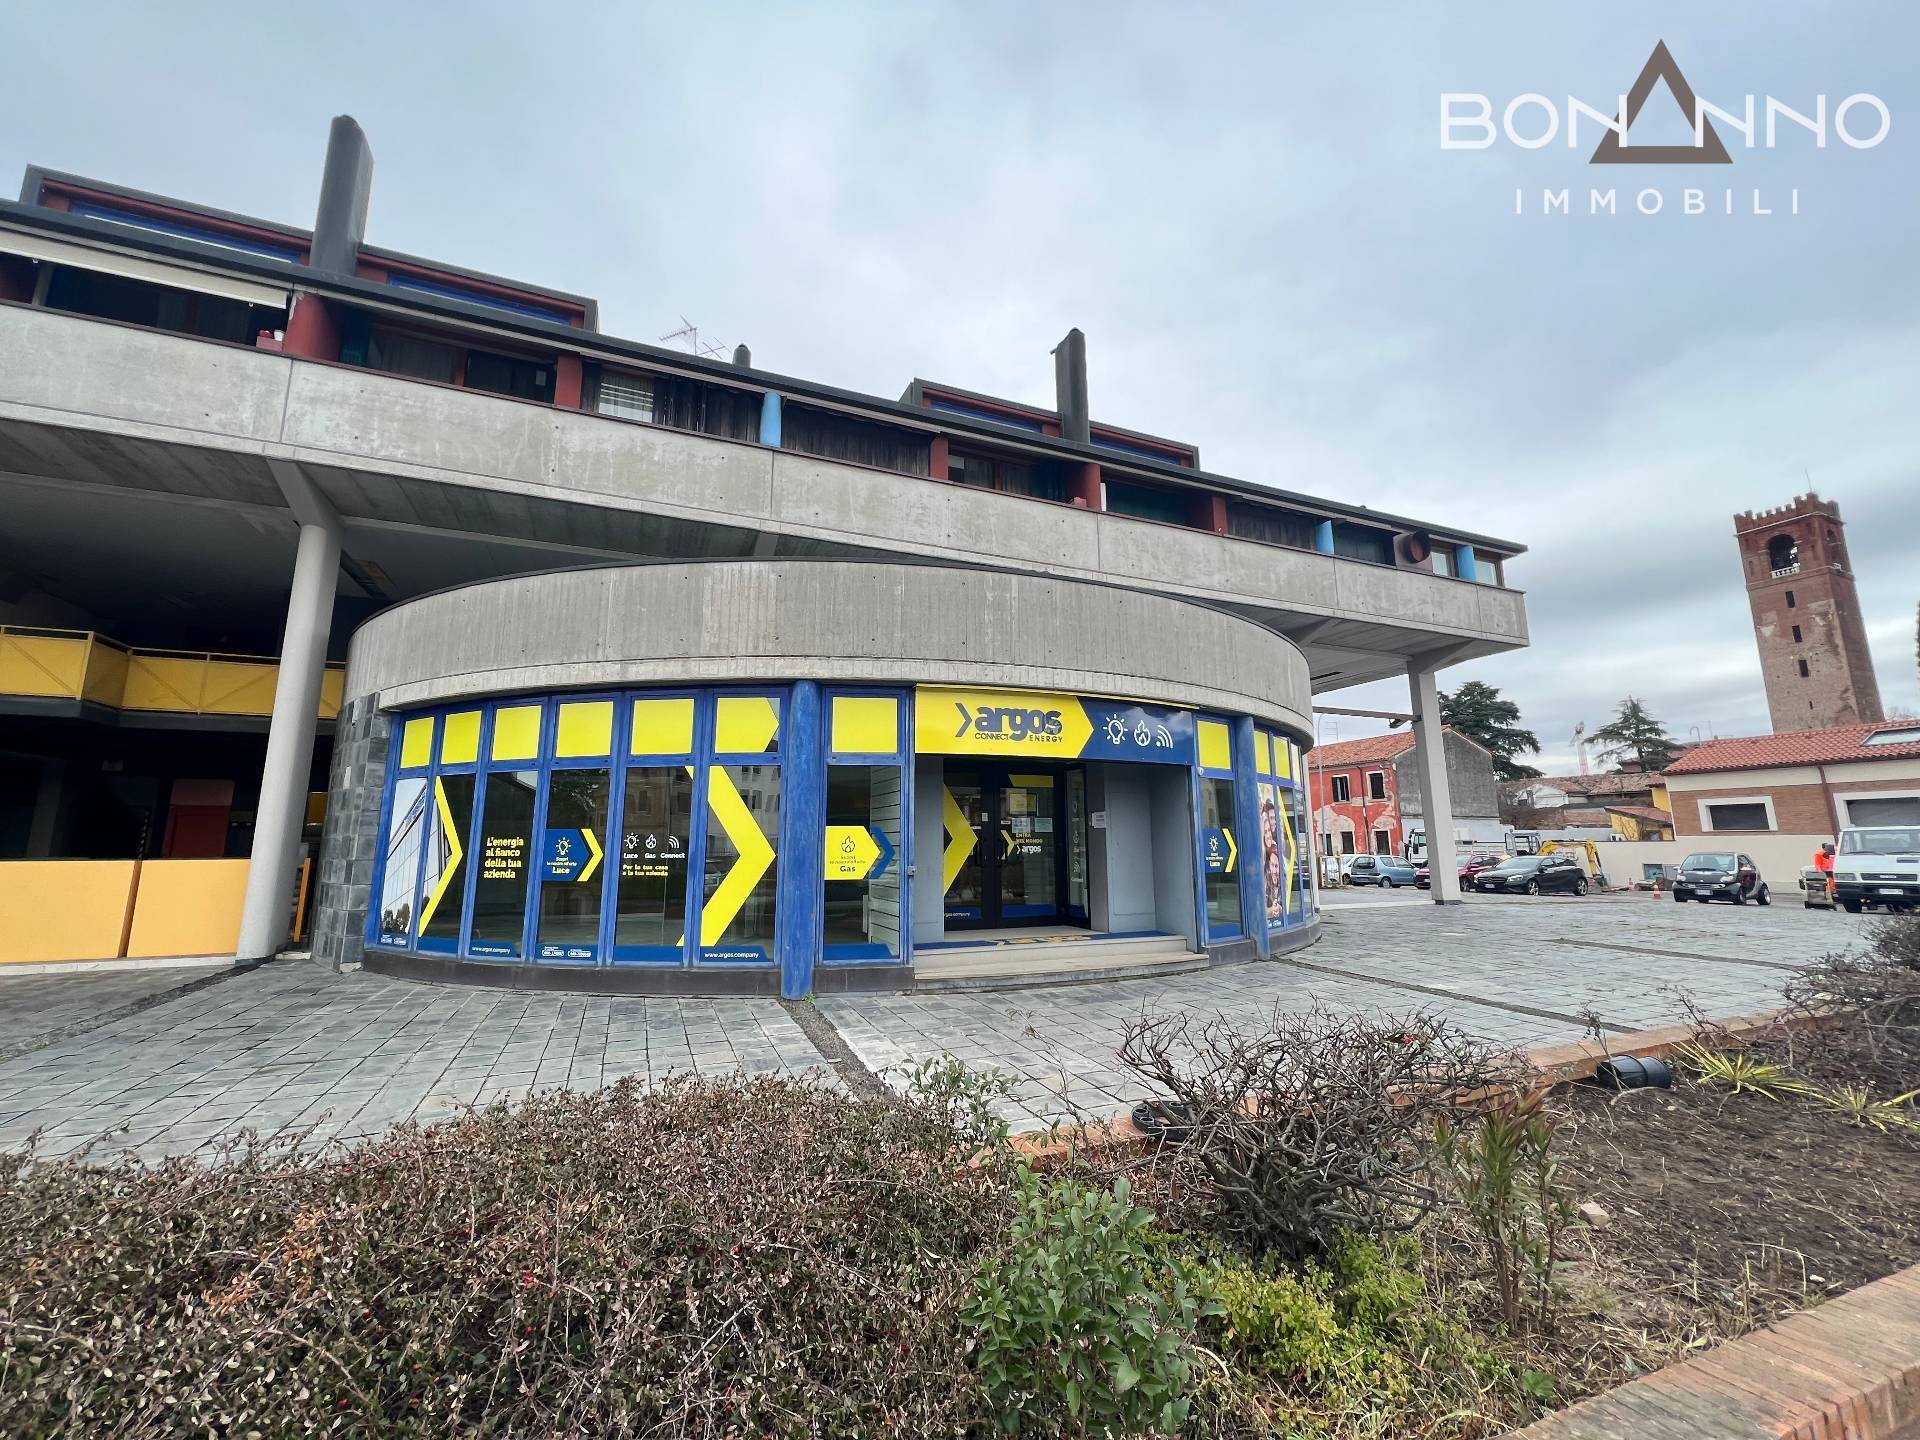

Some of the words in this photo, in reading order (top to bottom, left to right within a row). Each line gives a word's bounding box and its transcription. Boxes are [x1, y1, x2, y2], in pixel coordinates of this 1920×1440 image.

[975, 707, 1062, 741] argos
[975, 732, 1009, 740] CONNECT
[1029, 735, 1063, 743] ENERGY
[486, 836, 524, 848] L'energia
[495, 848, 521, 857] fianco
[1022, 845, 1042, 855] argos
[484, 858, 506, 868] della
[508, 859, 522, 868] tua
[483, 869, 516, 879] azienda
